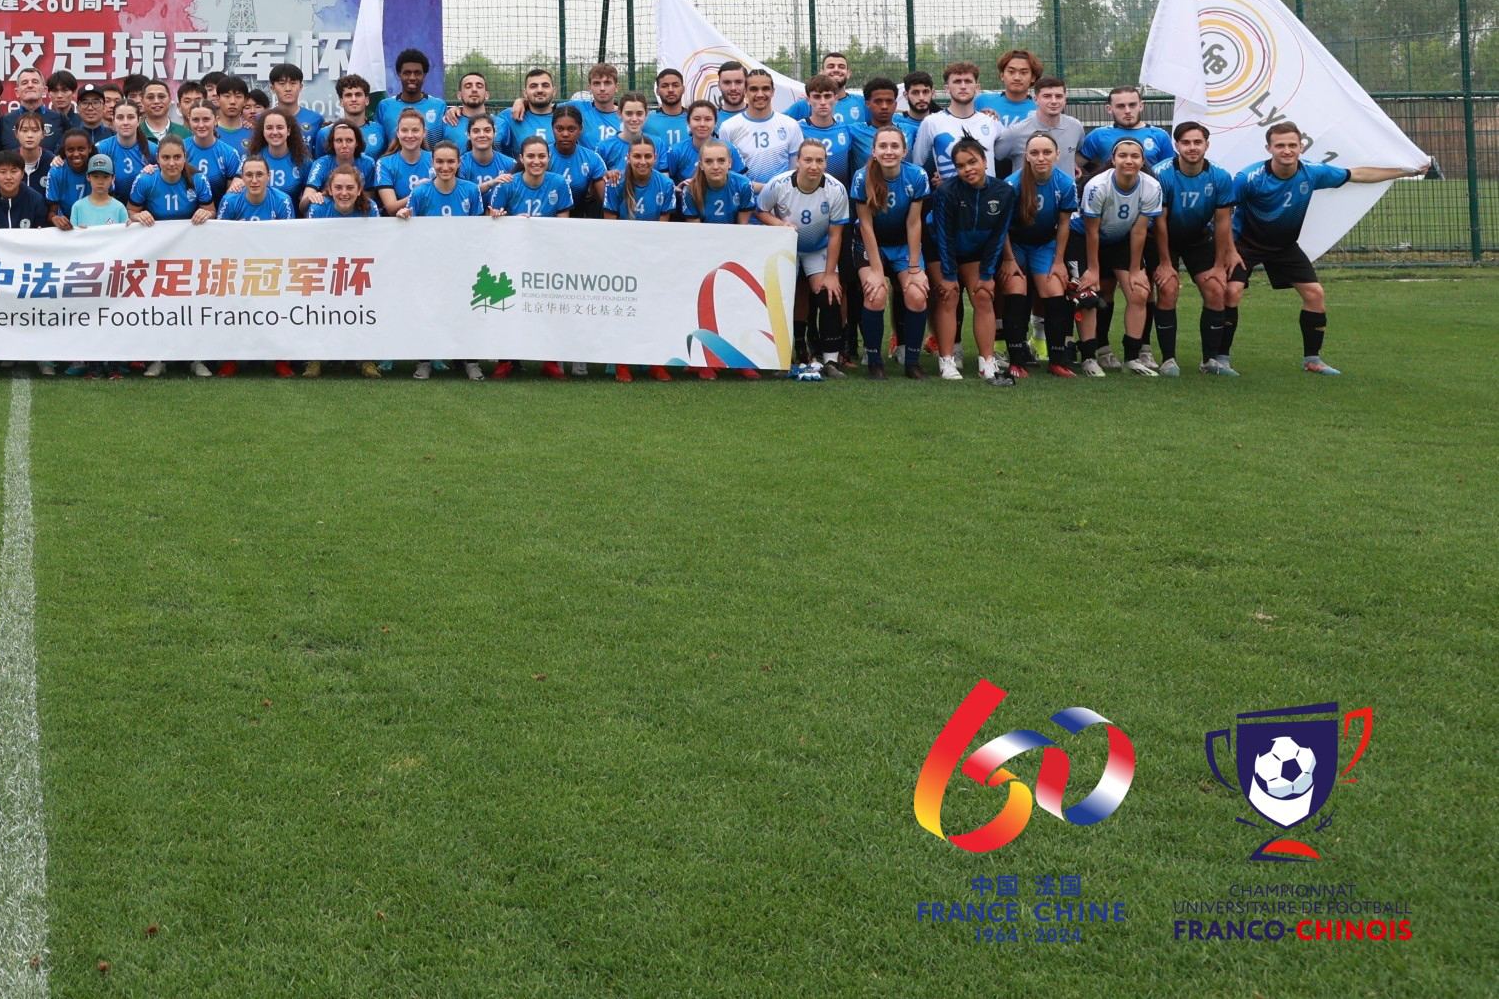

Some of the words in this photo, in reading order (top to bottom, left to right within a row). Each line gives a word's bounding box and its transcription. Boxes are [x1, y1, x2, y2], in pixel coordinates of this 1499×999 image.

[1249, 90, 1314, 155] Lyn
[666, 129, 681, 145] 11
[752, 131, 770, 149] 13
[123, 157, 134, 174] 3
[75, 183, 86, 200] 7
[1180, 190, 1200, 208] 17
[1282, 190, 1293, 208] 2
[165, 193, 179, 211] 11
[525, 199, 542, 217] 12
[714, 199, 725, 216] 2
[1117, 203, 1130, 219] 8
[800, 209, 812, 225] 8
[521, 271, 638, 293] REIGNWOOD
[98, 305, 193, 327] Football
[201, 304, 377, 326] Franco-Chinois
[522, 301, 637, 318] 北京华彬文化基金会
